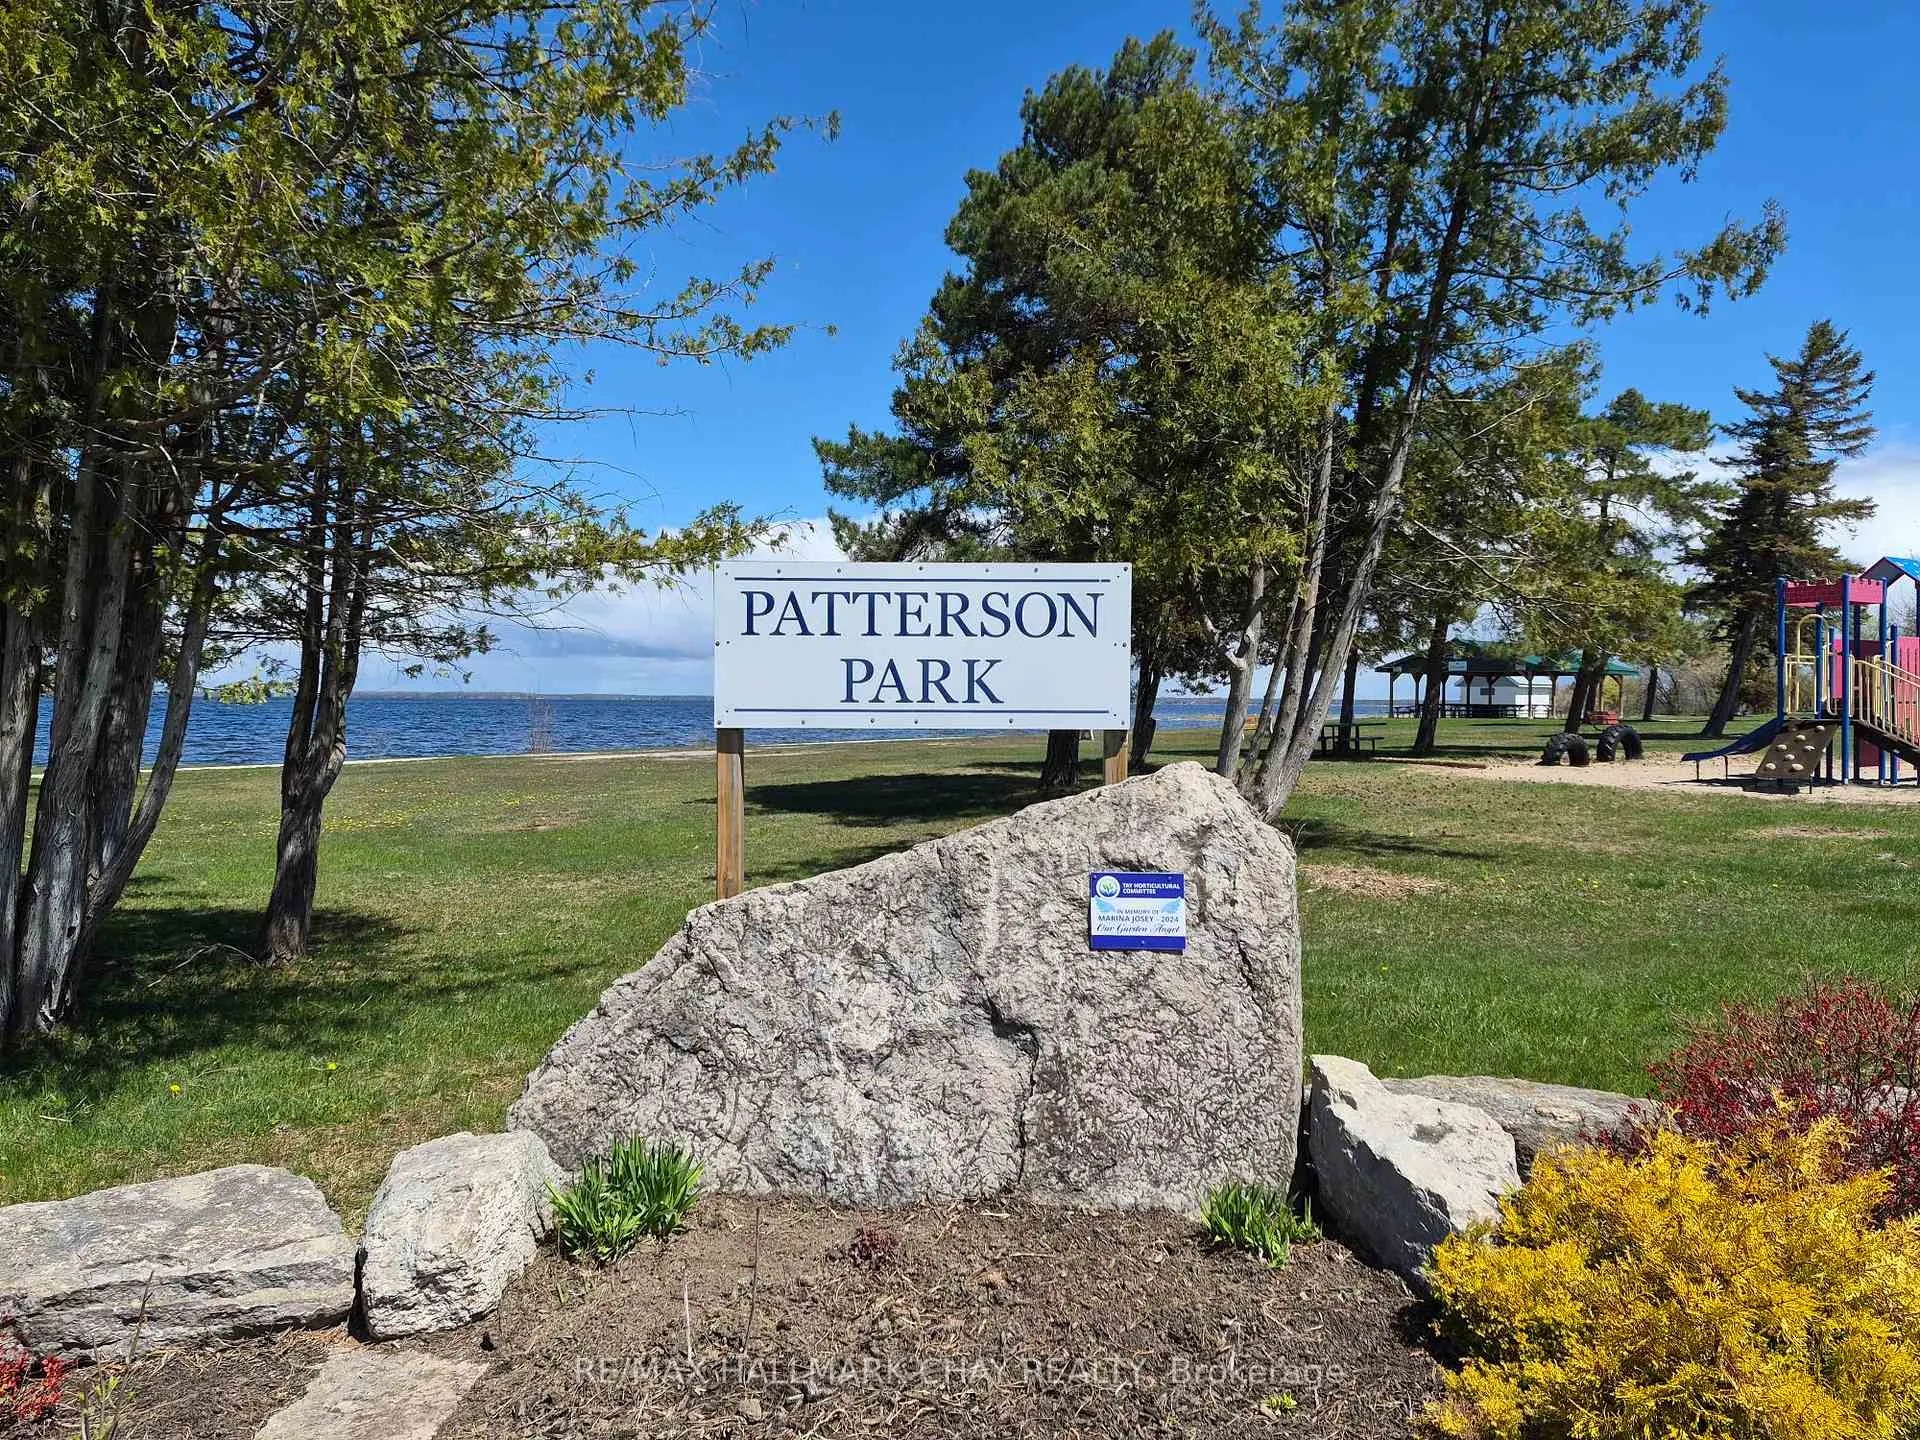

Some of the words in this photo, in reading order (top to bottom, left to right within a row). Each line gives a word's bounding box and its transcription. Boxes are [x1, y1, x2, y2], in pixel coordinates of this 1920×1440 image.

[740, 590, 1104, 638] PATTERSON
[840, 658, 1005, 704] PARK
[1134, 882, 1181, 890] HORTICULTURAL
[1131, 915, 1154, 923] JOSEY
[1161, 915, 1179, 923] 2024
[1096, 922, 1115, 932] Our
[1116, 922, 1148, 934] Garden
[1149, 924, 1180, 934] Angel
